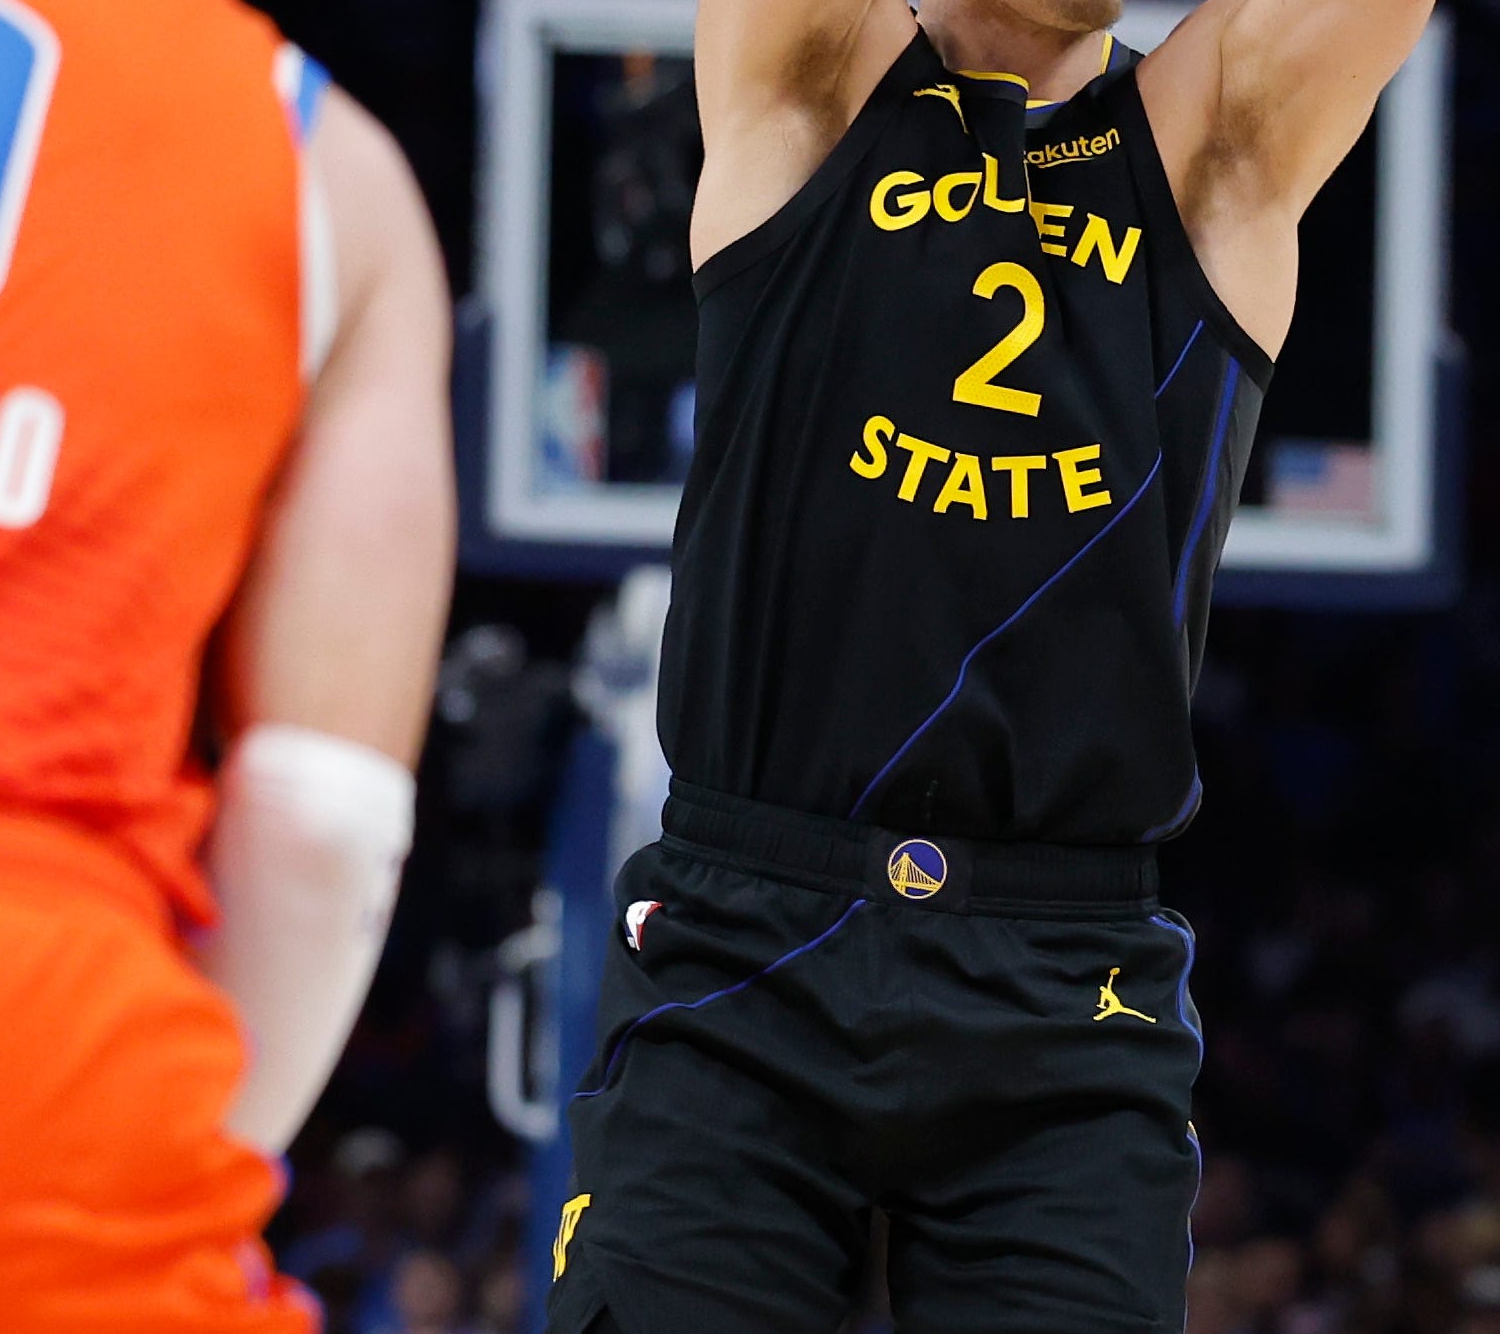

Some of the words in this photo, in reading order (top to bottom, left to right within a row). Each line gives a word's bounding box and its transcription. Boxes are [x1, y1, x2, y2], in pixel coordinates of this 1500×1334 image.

[1023, 127, 1121, 167] akuten
[870, 152, 1142, 285] GOLEN
[953, 261, 1045, 417] 2
[849, 415, 1112, 520] STATE
